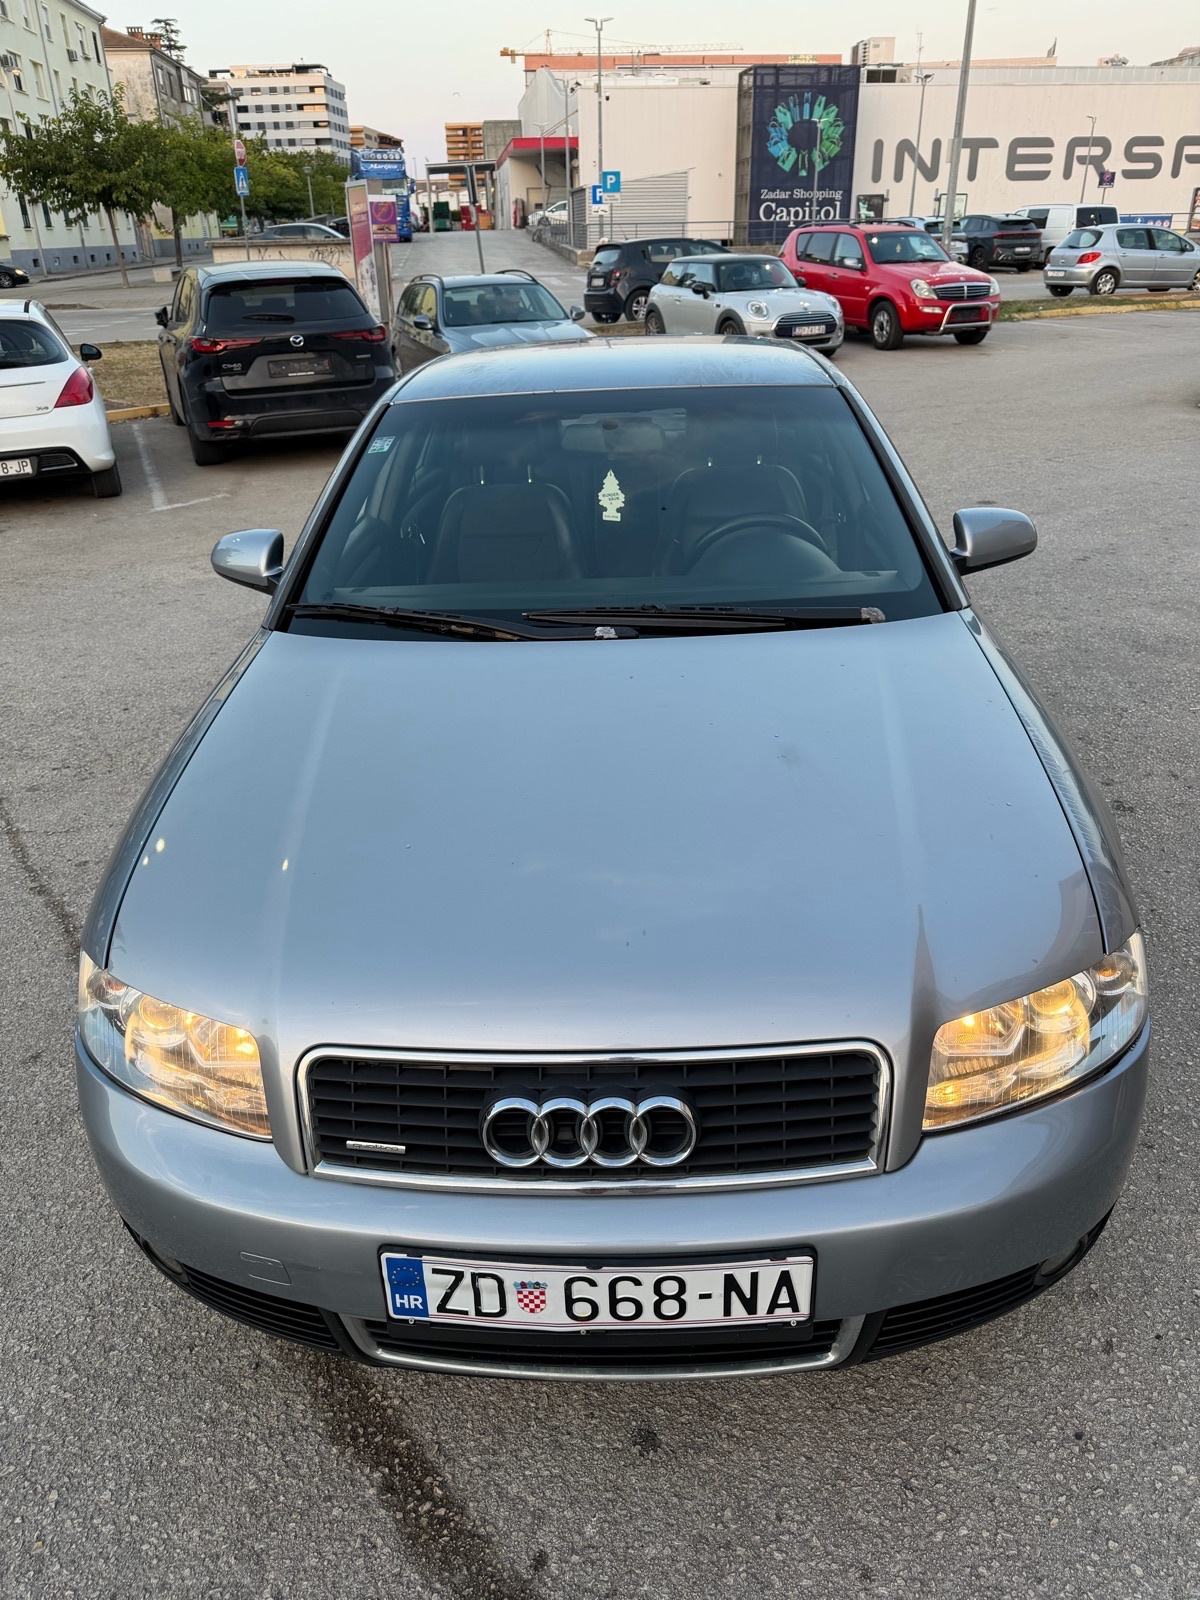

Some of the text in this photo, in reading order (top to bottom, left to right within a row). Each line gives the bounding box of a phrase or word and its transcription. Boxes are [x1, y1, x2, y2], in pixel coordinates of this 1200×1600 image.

[606, 175, 616, 189] P
[760, 188, 843, 200] Zadar Shopping
[759, 201, 841, 227] Capitol
[394, 1293, 426, 1311] HR
[429, 1268, 801, 1322] ZD 668-NA
